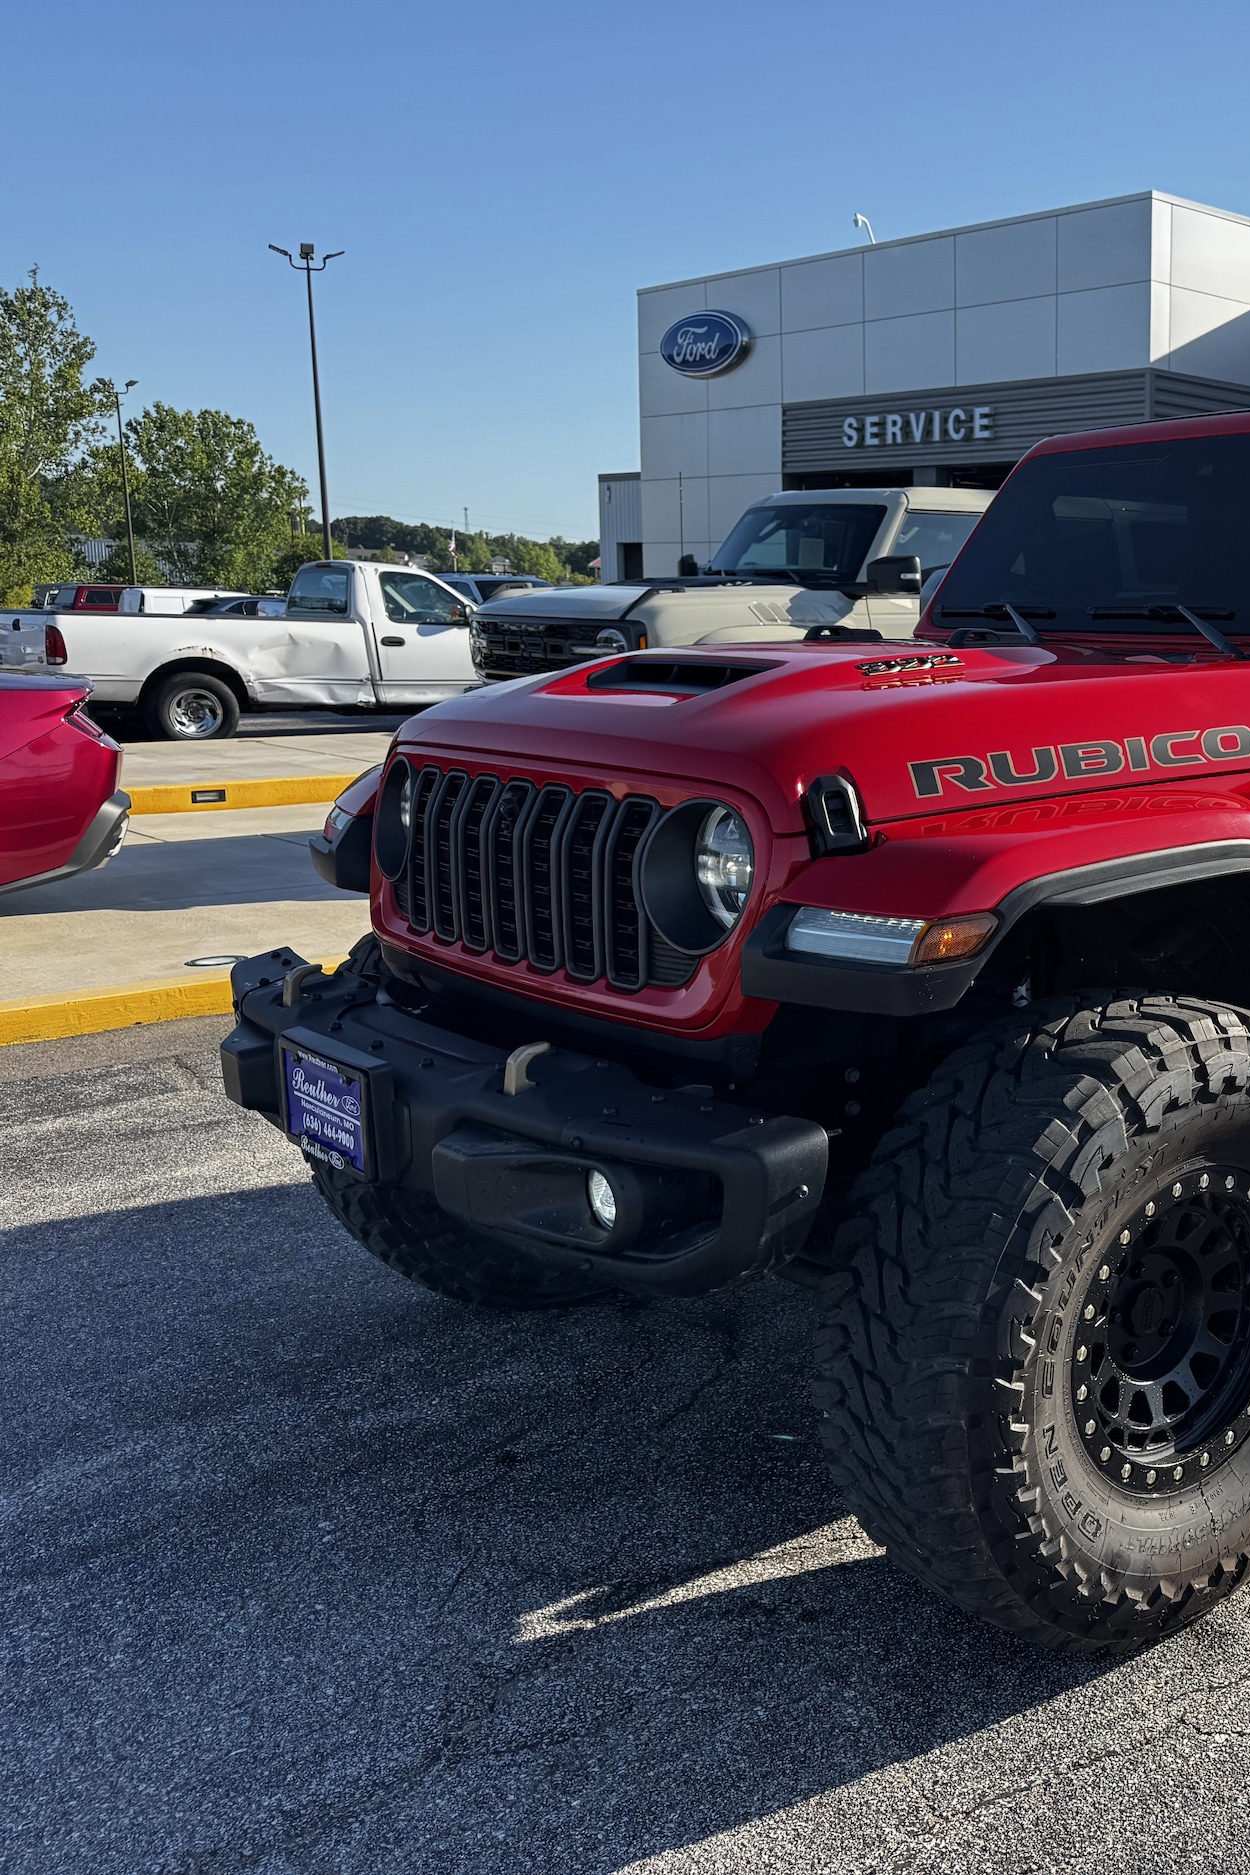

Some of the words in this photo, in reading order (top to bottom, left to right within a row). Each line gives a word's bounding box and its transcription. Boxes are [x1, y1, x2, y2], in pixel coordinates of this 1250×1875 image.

[673, 325, 720, 363] Ford
[842, 406, 995, 448] SERVICE
[292, 1067, 340, 1108] Reuther
[344, 1096, 358, 1114] Ford
[303, 1112, 321, 1136] (636)
[323, 1122, 354, 1150] 464-9000
[343, 1119, 354, 1131] MO
[1041, 1421, 1103, 1544] OPEN
